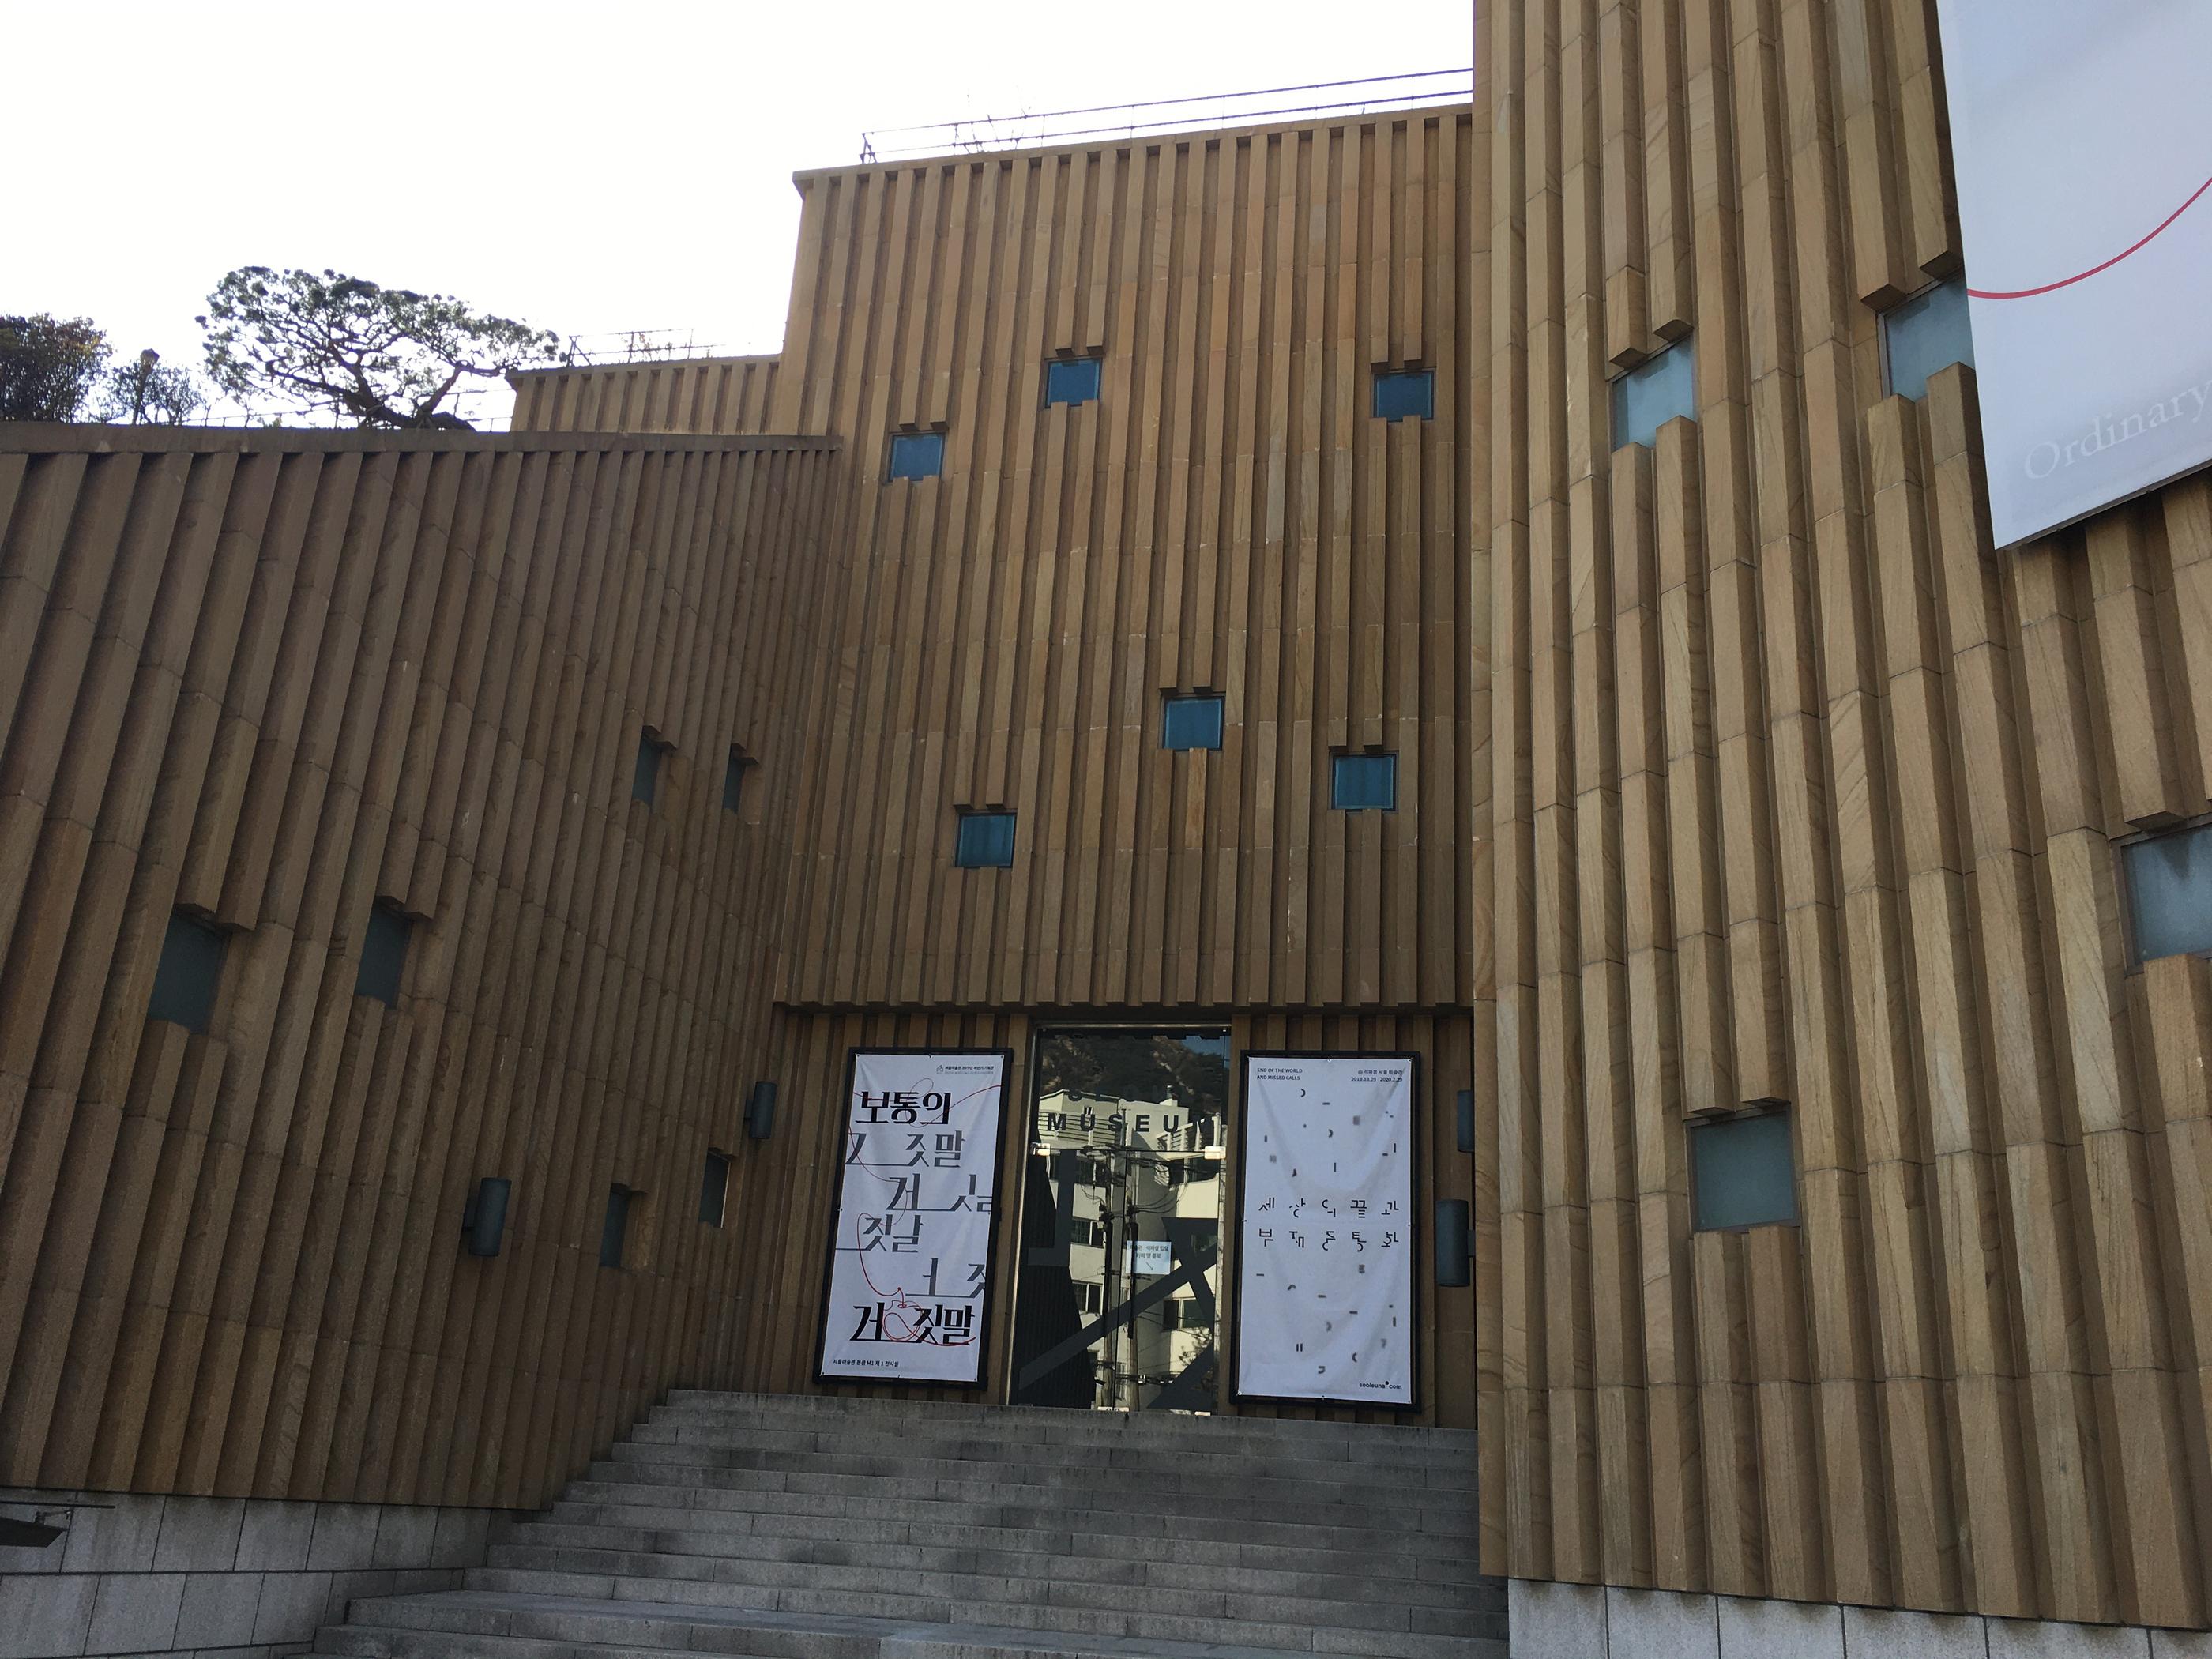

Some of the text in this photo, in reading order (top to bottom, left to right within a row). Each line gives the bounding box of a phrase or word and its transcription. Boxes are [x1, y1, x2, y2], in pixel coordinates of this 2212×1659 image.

[2024, 378, 2212, 480] Ordinary
[855, 1091, 952, 1125] 보통의
[849, 1302, 975, 1346] 거짓말
